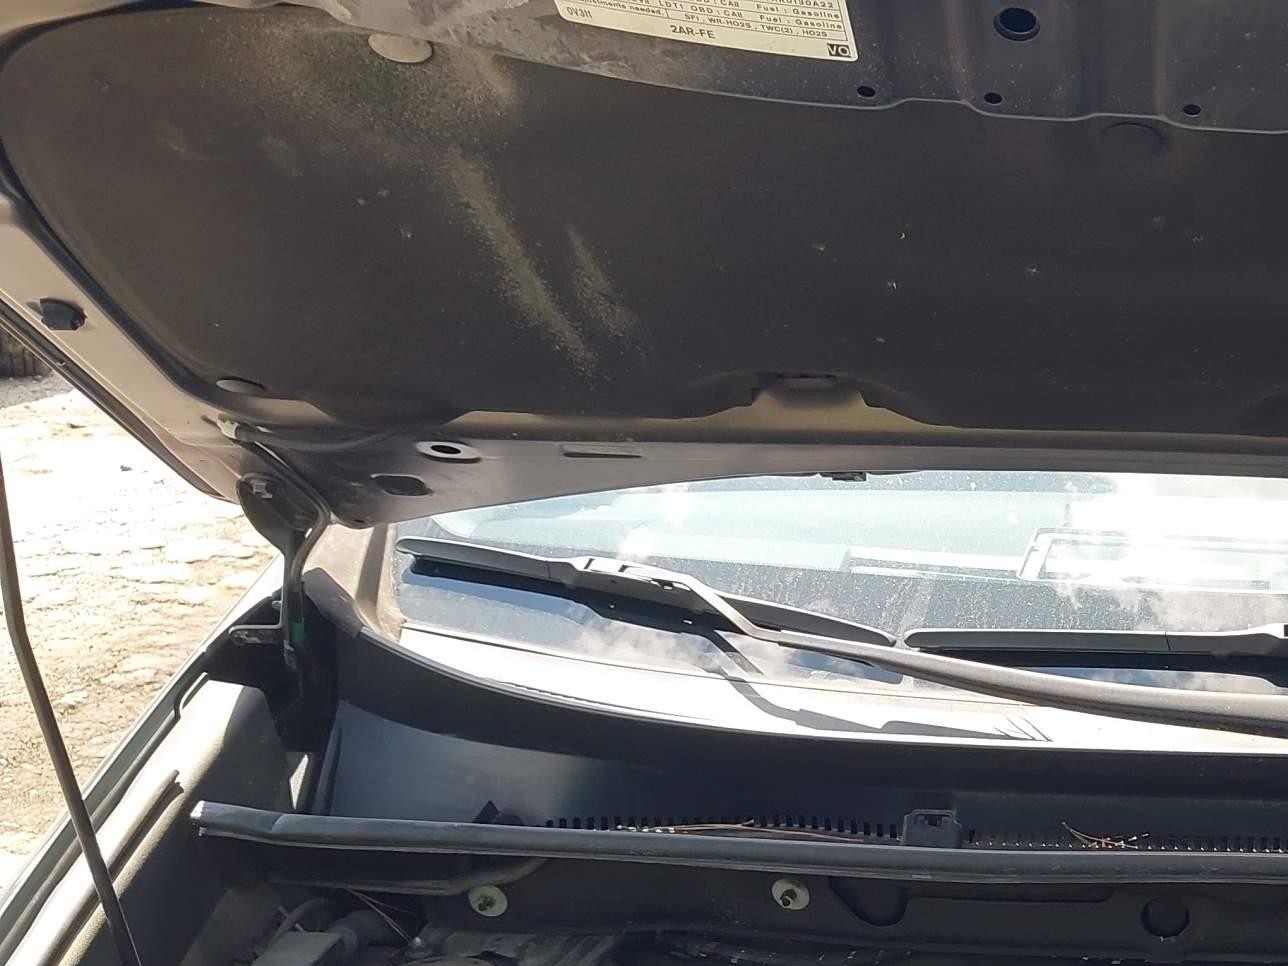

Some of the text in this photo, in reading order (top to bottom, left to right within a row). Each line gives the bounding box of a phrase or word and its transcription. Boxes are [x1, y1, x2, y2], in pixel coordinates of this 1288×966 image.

[691, 5, 713, 13] OBD
[760, 15, 782, 23] Fuel
[795, 19, 842, 29] Gasoline
[756, 4, 779, 12] Fuel
[793, 9, 840, 19] Gasoline
[670, 24, 716, 39] 2AR-FE
